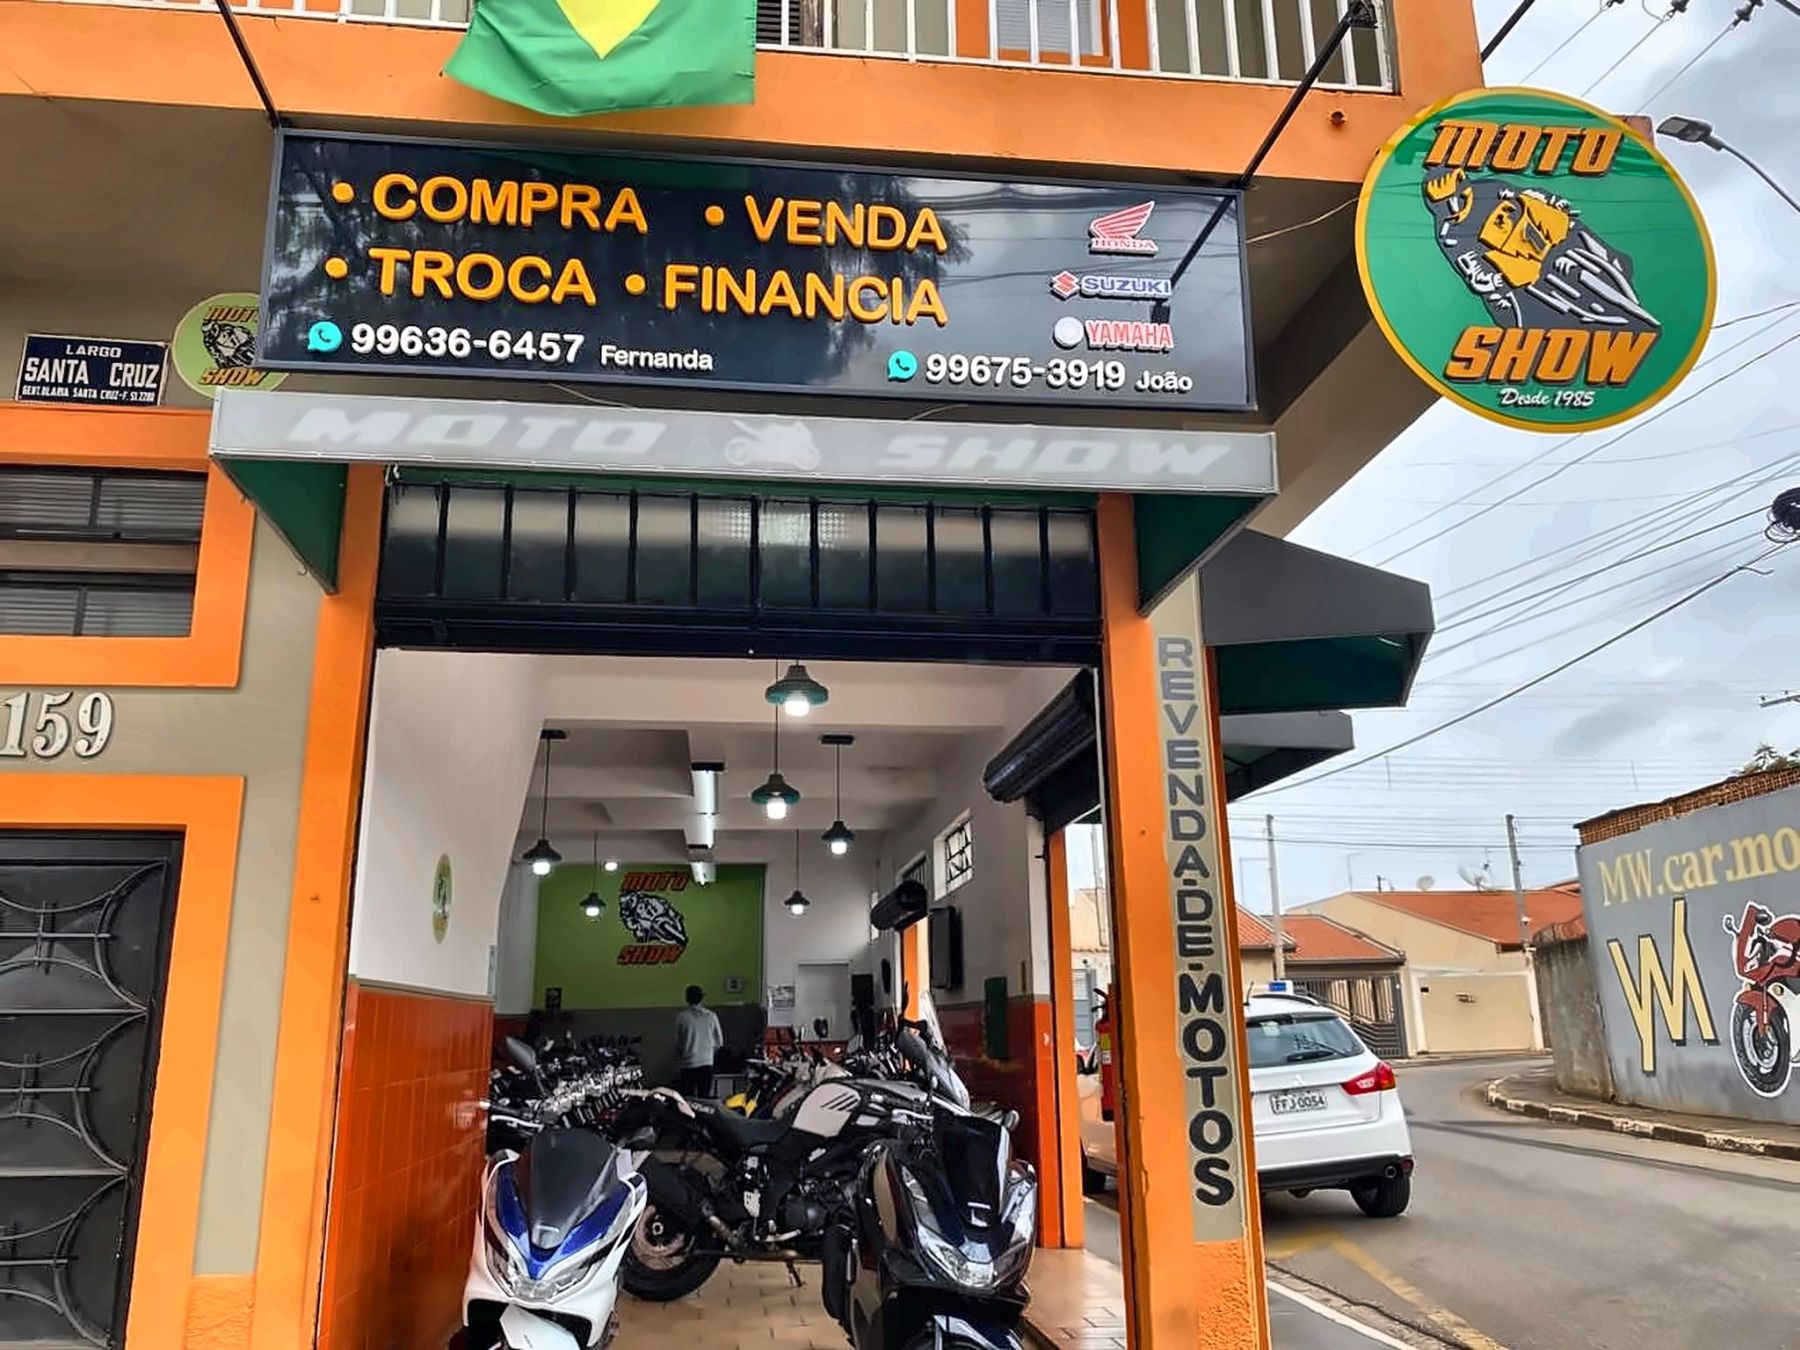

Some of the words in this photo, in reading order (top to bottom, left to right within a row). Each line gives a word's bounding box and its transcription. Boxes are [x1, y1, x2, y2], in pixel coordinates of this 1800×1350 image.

[1423, 120, 1624, 176] MOTO
[373, 173, 649, 234] COMPRA
[744, 195, 948, 252] VENDA
[1094, 239, 1156, 250] HONDA
[368, 247, 597, 306] TROCA
[664, 263, 948, 327] FINANCIA
[1084, 276, 1171, 293] SUZUKI
[350, 323, 585, 364] 99636-6457
[600, 345, 714, 372] Fernanda
[1087, 322, 1173, 346] YAMAHA
[65, 344, 122, 358] LARGO
[1445, 325, 1658, 385] SHOW
[24, 357, 89, 385] SANTA
[109, 362, 160, 389] CRUZ
[199, 367, 268, 386] SHOW
[925, 353, 1126, 389] 99675-3919
[1137, 369, 1193, 392] João
[73, 387, 98, 399] SANTA
[1500, 388, 1550, 405] Desde
[1553, 390, 1596, 407] 1985
[288, 407, 669, 455] MOTO
[878, 433, 1230, 476] SHOW
[0, 691, 113, 758] 159
[620, 872, 690, 892] MOTO
[617, 944, 688, 965] SHOW
